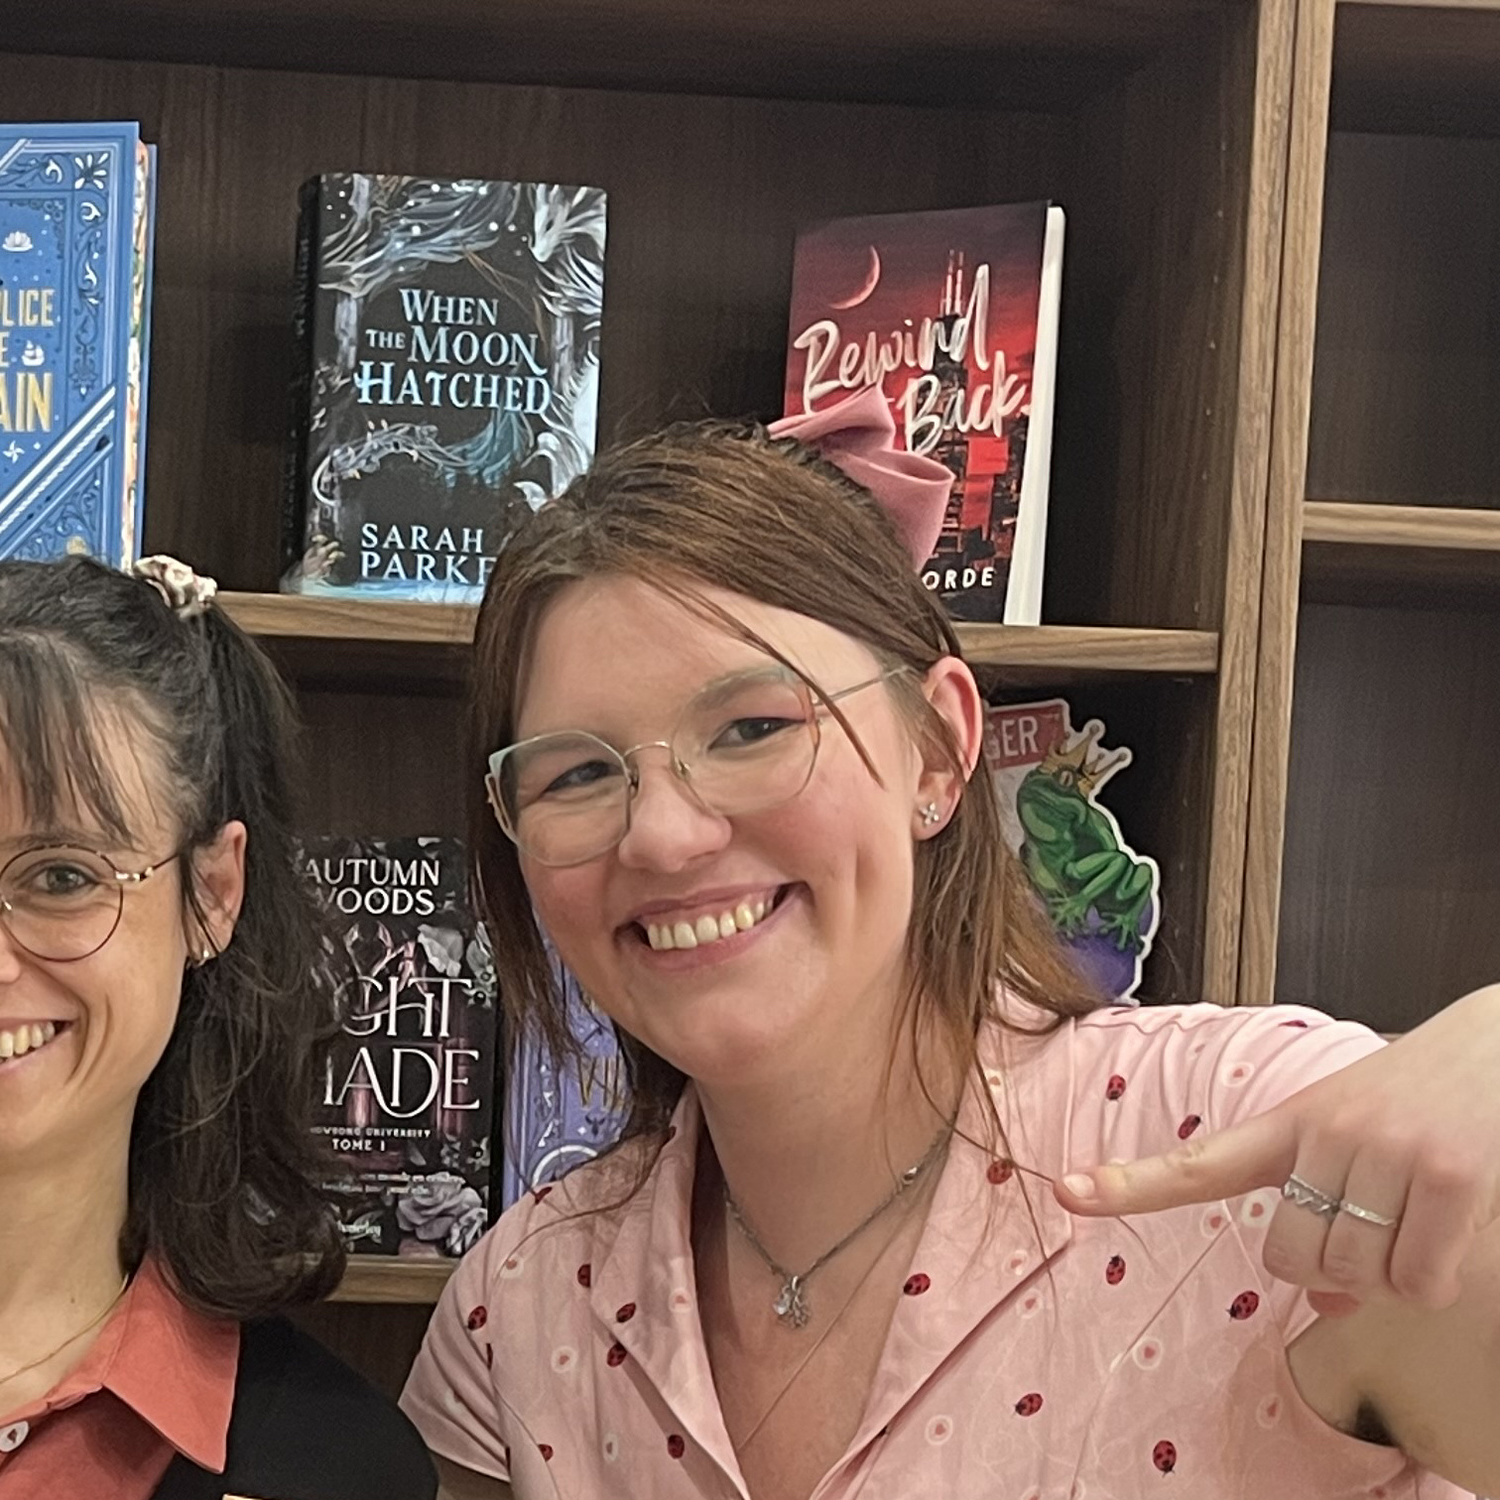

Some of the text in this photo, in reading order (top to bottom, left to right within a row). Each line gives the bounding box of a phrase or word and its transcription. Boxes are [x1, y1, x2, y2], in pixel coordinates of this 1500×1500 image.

[400, 289, 499, 325] WHEN
[366, 325, 547, 375] THE MOON
[794, 264, 989, 415] Rewind
[354, 360, 552, 414] HATCHED
[896, 350, 1032, 457] Back
[361, 523, 483, 553] SARAH
[922, 566, 995, 591] ORDE
[304, 858, 440, 887] AUTUMN
[332, 1138, 373, 1151] TOME
